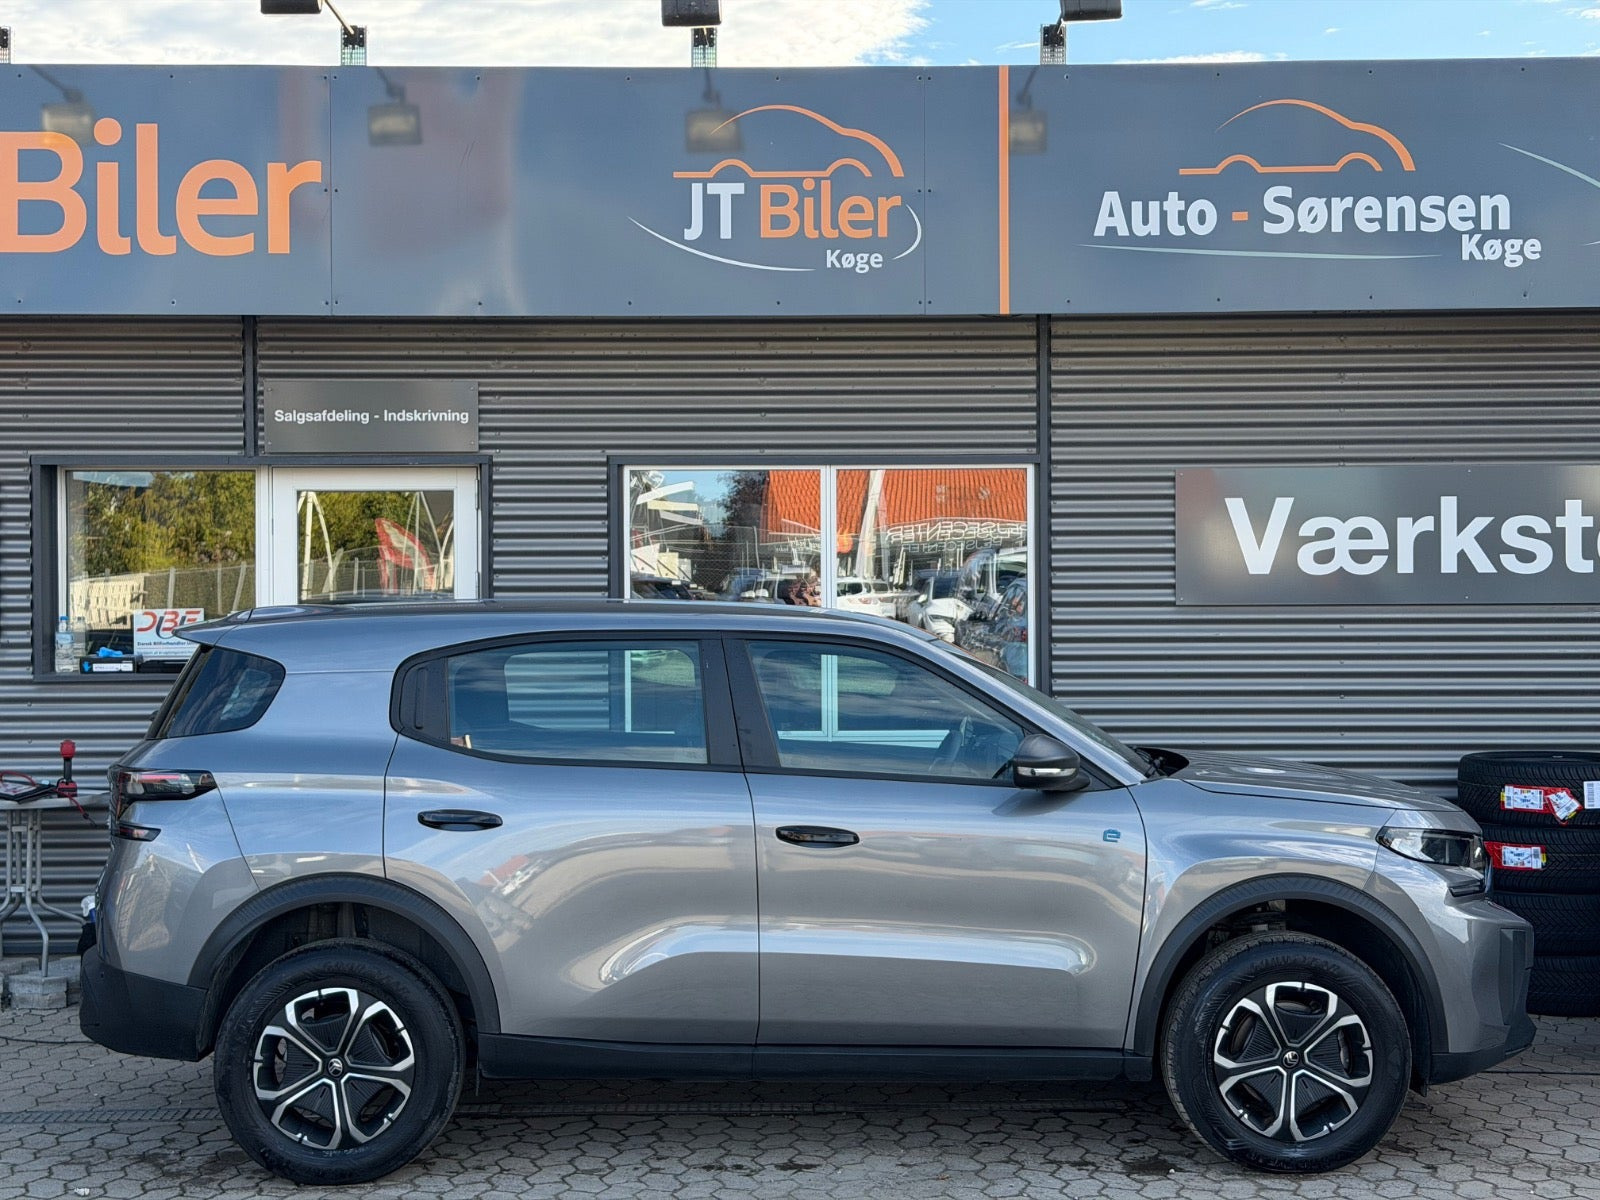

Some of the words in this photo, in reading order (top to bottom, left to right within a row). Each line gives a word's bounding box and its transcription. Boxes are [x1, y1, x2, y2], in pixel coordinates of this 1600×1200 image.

[0, 118, 322, 256] Biler
[684, 182, 745, 241] JT
[760, 178, 902, 239] Biler
[1093, 190, 1218, 237] Auto
[1263, 185, 1510, 234] Sørensen
[826, 249, 883, 274] Køge
[1461, 232, 1541, 268] Køge
[274, 409, 370, 425] Salgsafdeling
[384, 409, 470, 425] Indskrivning
[1224, 495, 1600, 576] Værkst
